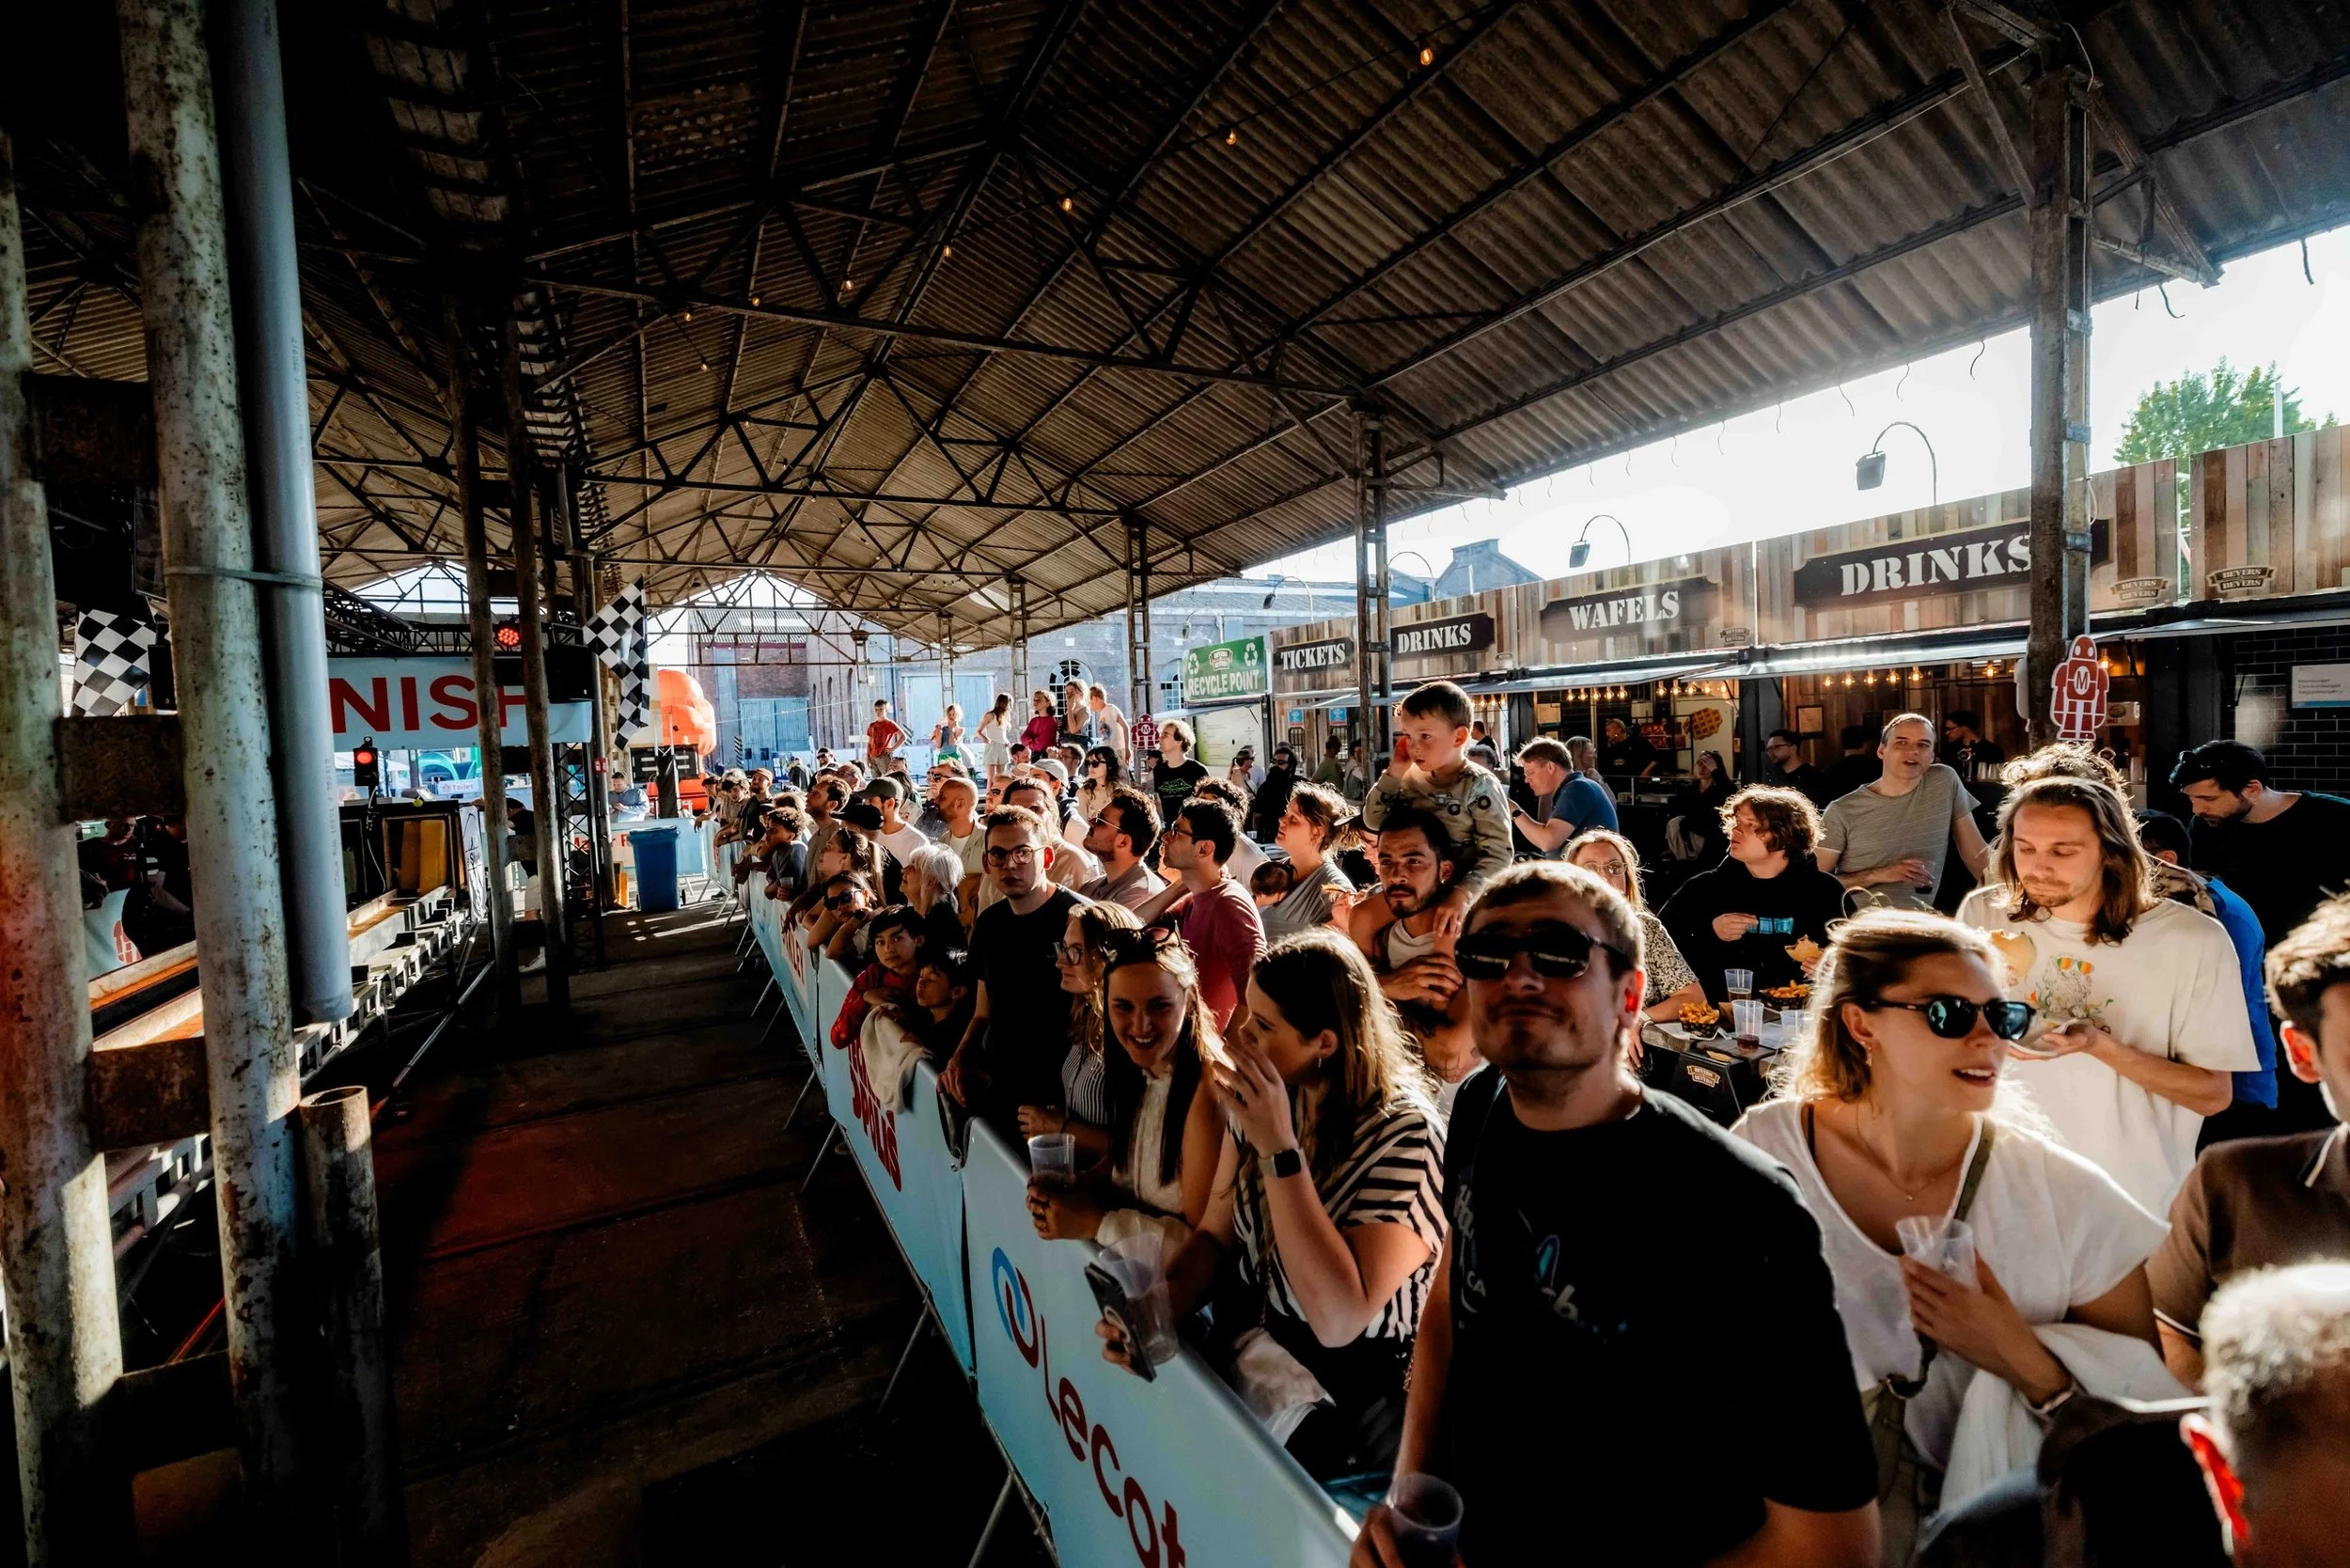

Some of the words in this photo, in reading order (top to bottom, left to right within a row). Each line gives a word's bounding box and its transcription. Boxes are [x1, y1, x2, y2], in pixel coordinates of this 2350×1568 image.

[1839, 534, 2033, 598] DRINKS
[2221, 568, 2262, 579] BEVERS
[2121, 580, 2157, 589] BEVERS
[2221, 579, 2262, 589] BEVERS
[1568, 590, 1681, 632] WAFELS
[1397, 622, 1472, 654] DRINKS
[1280, 643, 1346, 670] TICKETS
[1187, 675, 1228, 697] RECYCLE
[1230, 670, 1260, 692] POINT
[2076, 670, 2088, 690] M
